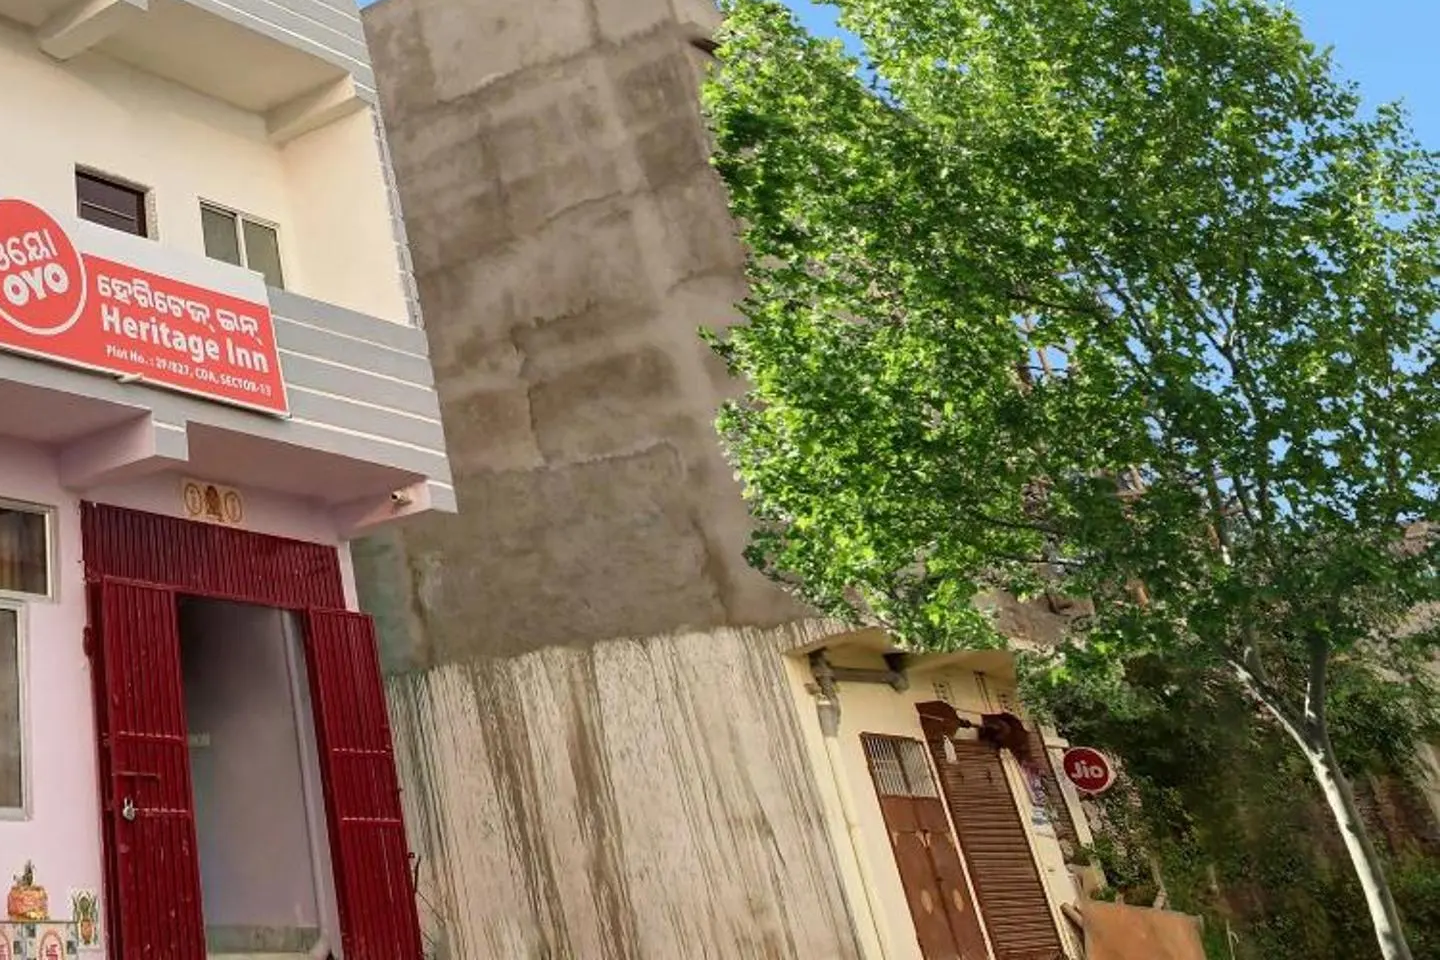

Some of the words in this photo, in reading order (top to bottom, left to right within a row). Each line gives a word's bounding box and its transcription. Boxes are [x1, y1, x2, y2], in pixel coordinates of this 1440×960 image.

[3, 262, 69, 306] OYO
[100, 304, 220, 363] Heritage
[226, 338, 269, 373] Inn
[106, 344, 128, 360] Plot
[1071, 760, 1104, 779] Jio
